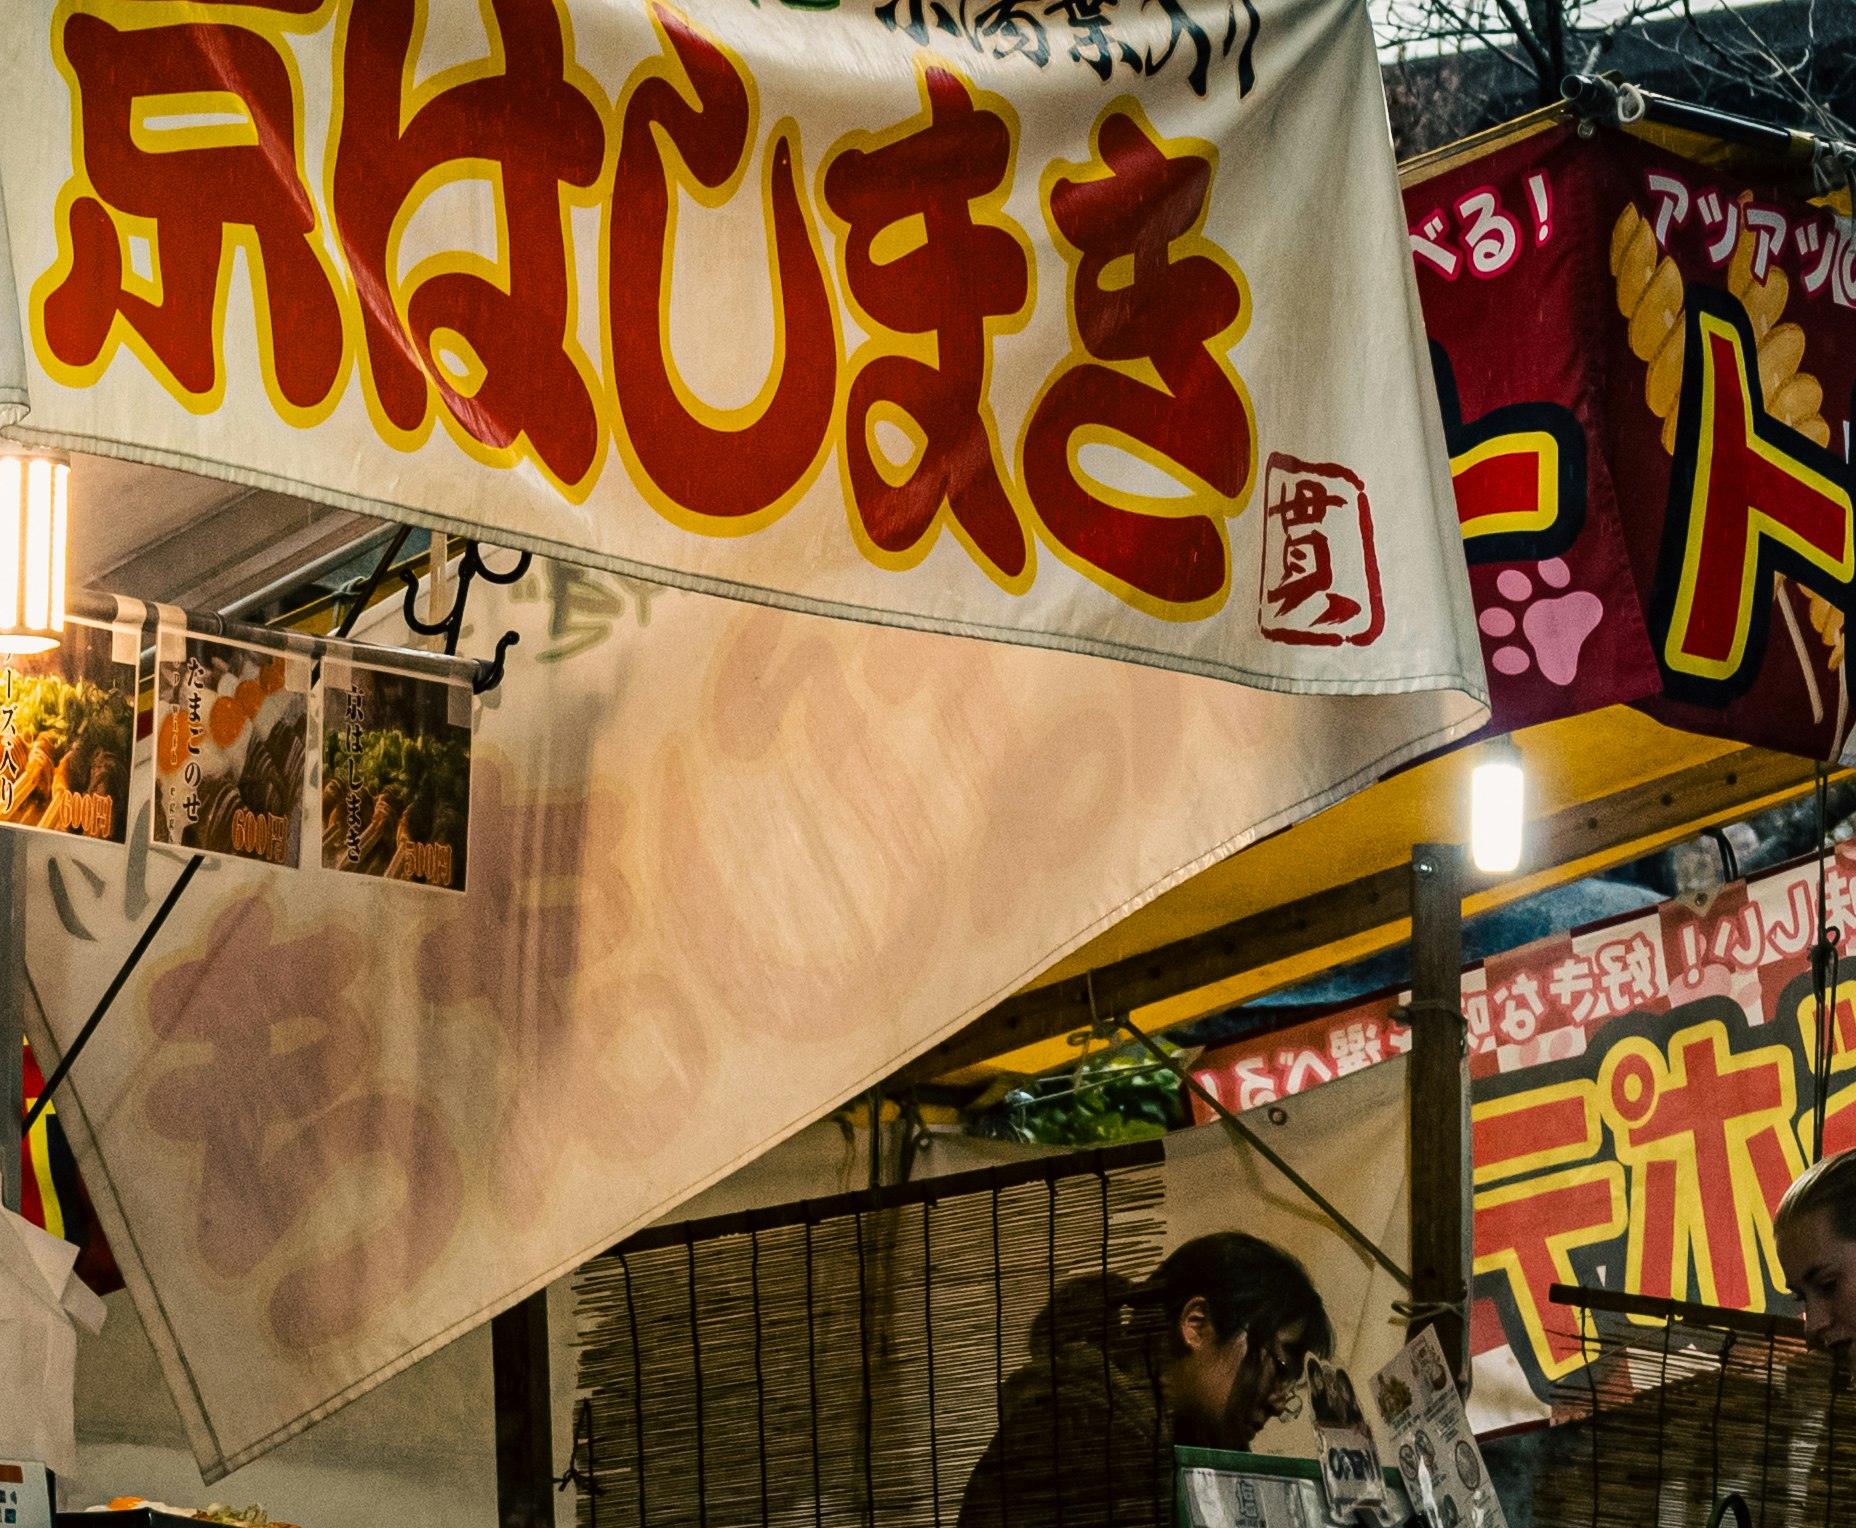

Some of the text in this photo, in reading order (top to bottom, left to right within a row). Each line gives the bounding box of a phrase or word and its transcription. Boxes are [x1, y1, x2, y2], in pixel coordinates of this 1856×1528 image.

[182, 656, 206, 824] たまごのせ
[343, 684, 366, 864] 京はしまき
[59, 789, 114, 839] 600円
[231, 808, 288, 865] 600円
[402, 840, 453, 887] 500円
